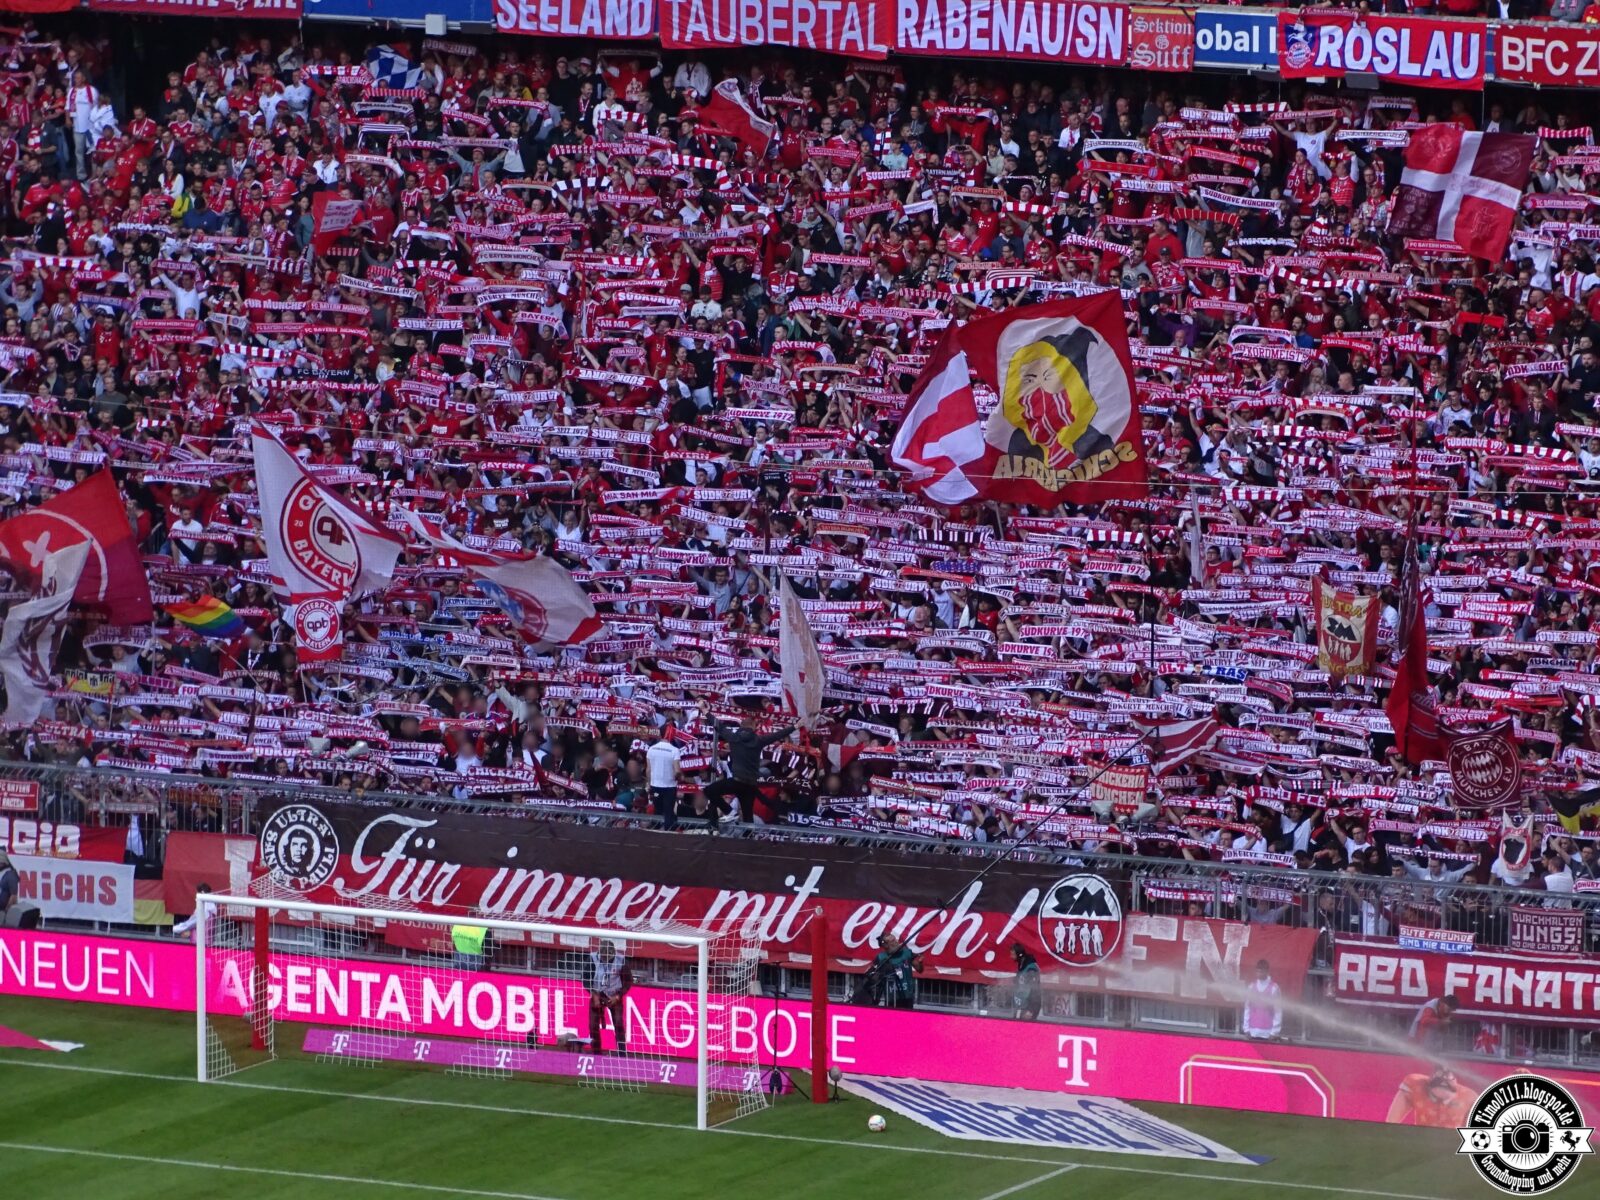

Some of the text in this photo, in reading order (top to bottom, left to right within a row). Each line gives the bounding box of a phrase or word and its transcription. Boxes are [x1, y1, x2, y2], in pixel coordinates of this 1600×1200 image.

[496, 0, 653, 37] SEELAND
[668, 0, 888, 53] TAUBERTAL
[899, 0, 1123, 60] RABENAU/SN
[1315, 20, 1480, 79] RÖSLAU
[1502, 35, 1600, 77] BFC Z
[520, 312, 559, 324] BAYERN
[1398, 341, 1436, 353] SAN MIA
[297, 368, 310, 376] FC
[341, 382, 362, 391] SAN
[444, 401, 477, 413] FCB
[619, 491, 638, 500] SAN
[640, 489, 658, 499] MIA
[694, 489, 722, 500] SÜDK
[886, 544, 914, 553] BAYERN
[749, 554, 817, 566] SÜDK URVE
[1020, 626, 1068, 638] SÜDKURVE
[1449, 713, 1489, 723] BAYERN
[298, 846, 336, 890] PAULI
[332, 812, 1040, 963] Für immer mit euch!
[1511, 923, 1582, 945] JUNGS!
[0, 938, 155, 999] NEUEN
[422, 976, 579, 1038] MOBIL
